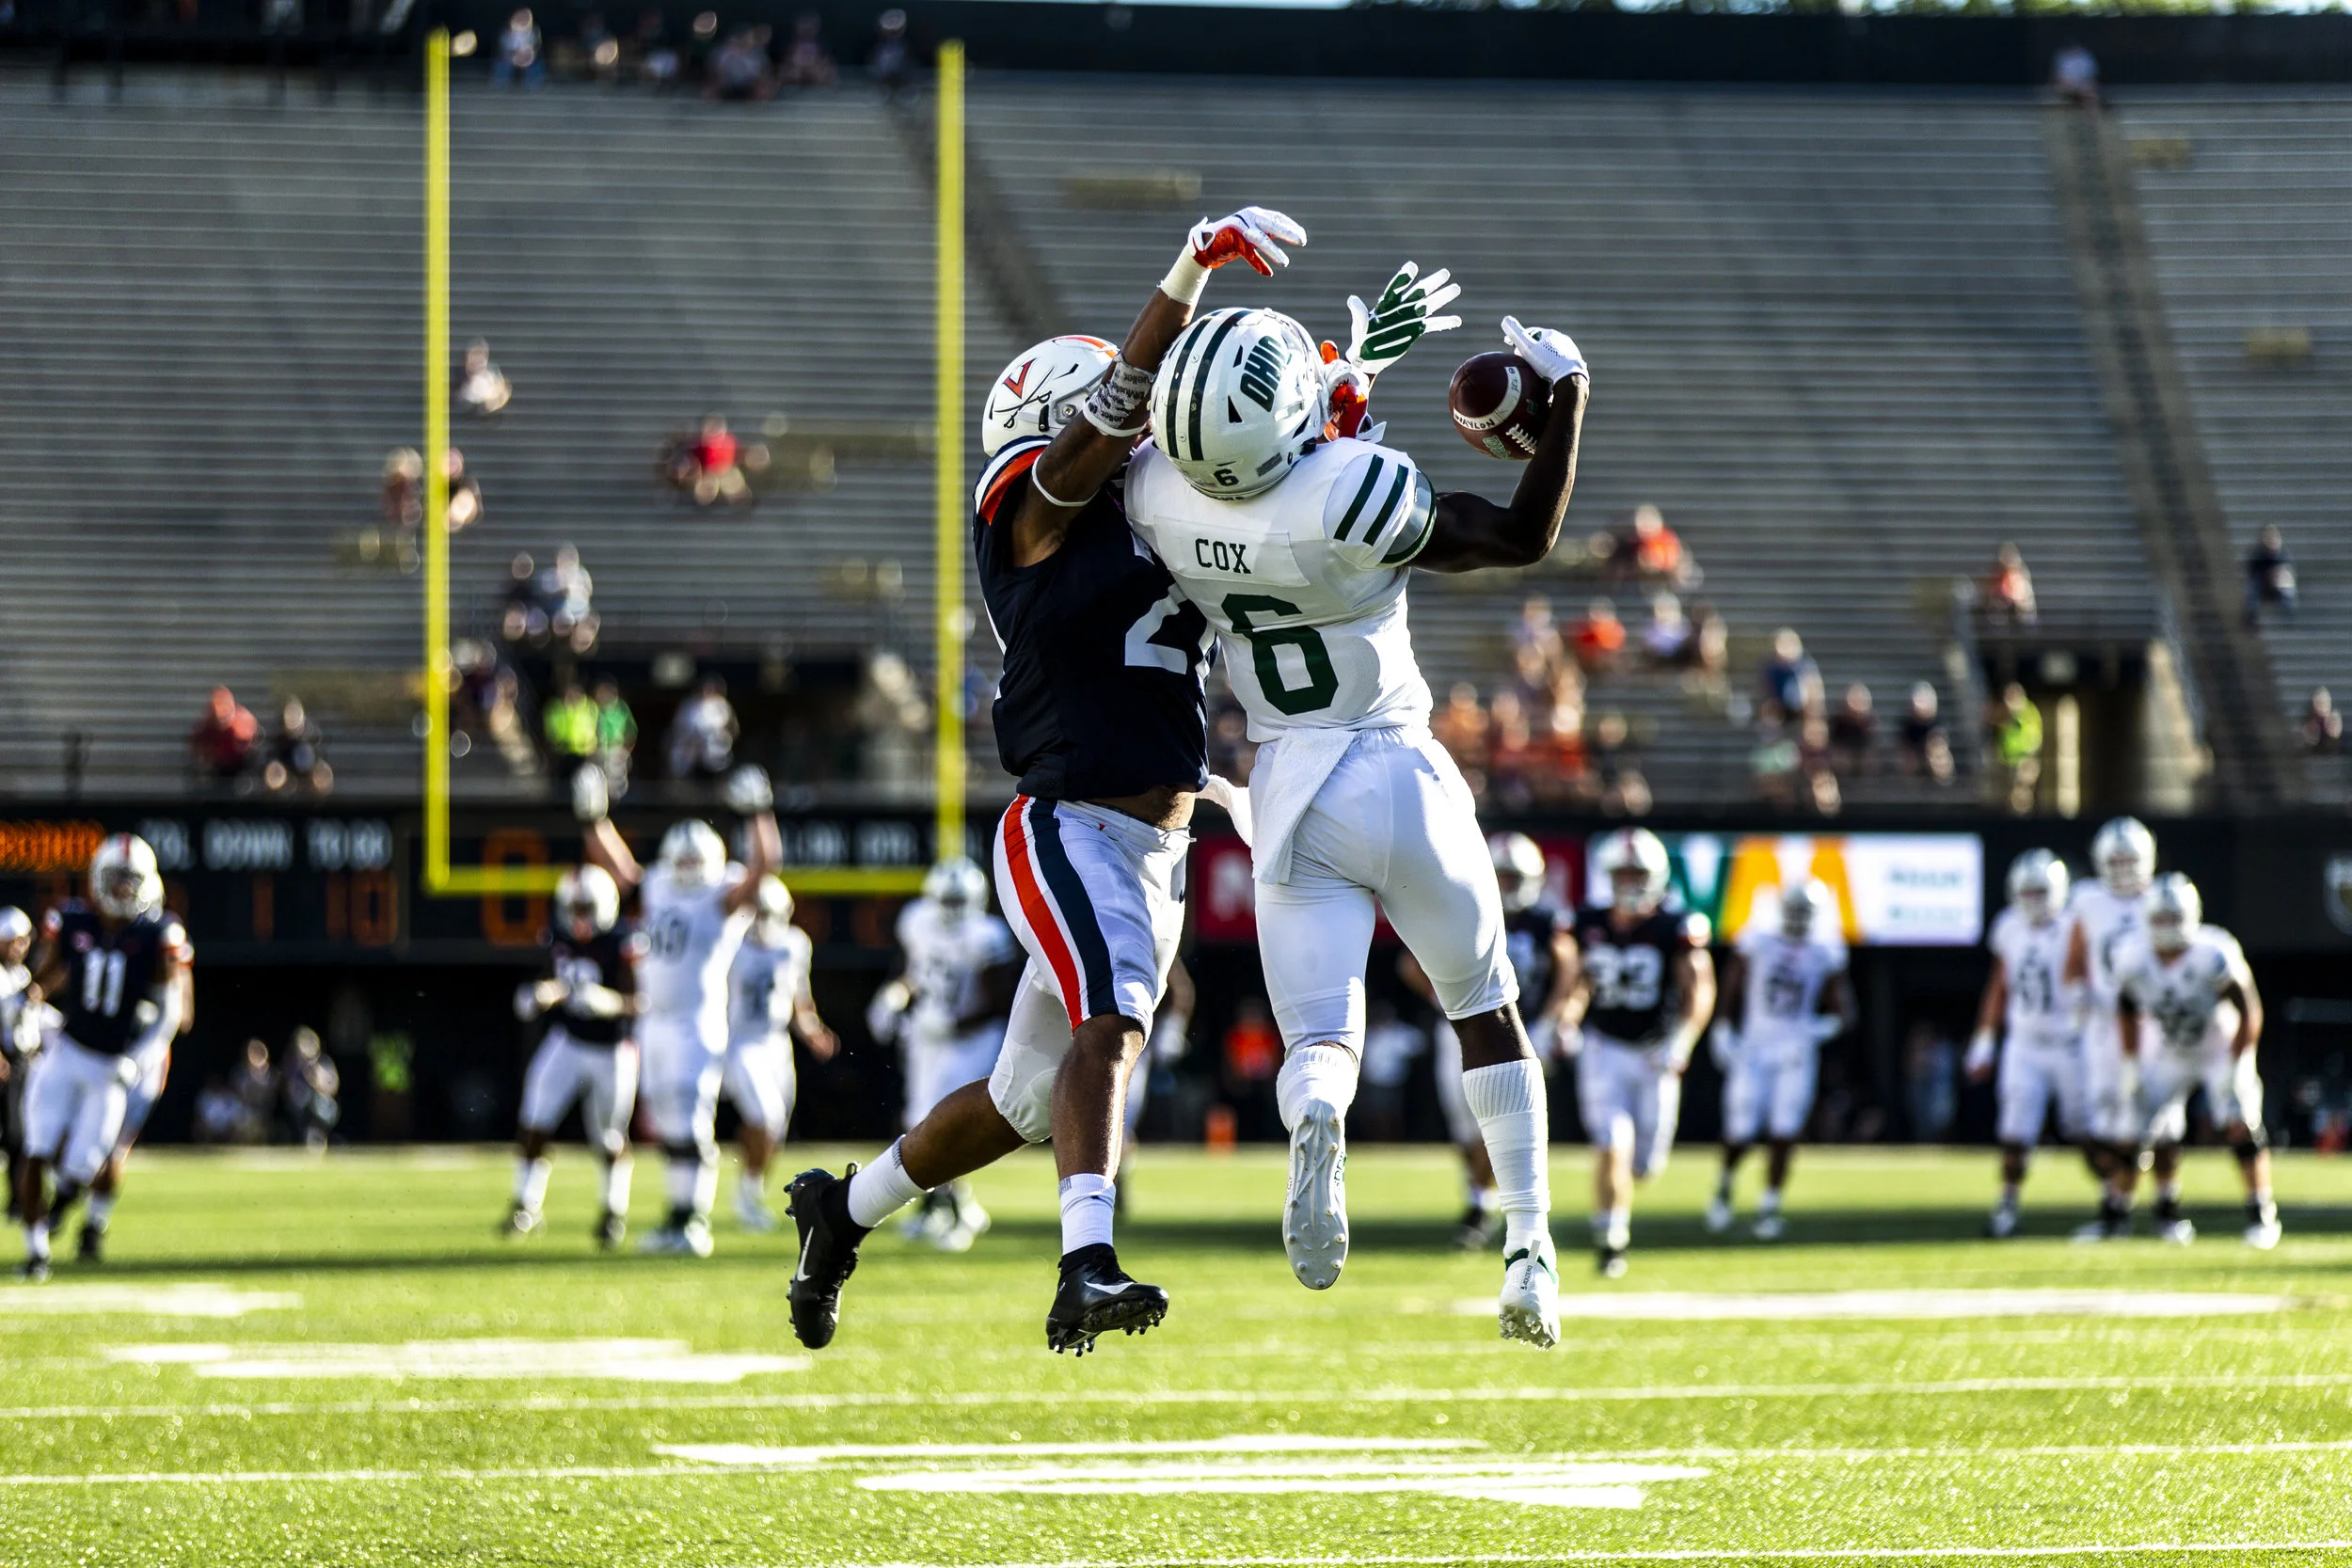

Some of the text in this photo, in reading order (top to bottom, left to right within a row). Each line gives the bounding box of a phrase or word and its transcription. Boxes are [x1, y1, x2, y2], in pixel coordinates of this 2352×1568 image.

[1213, 468, 1241, 487] 6
[1195, 537, 1252, 575] COX
[1220, 593, 1340, 716] 6
